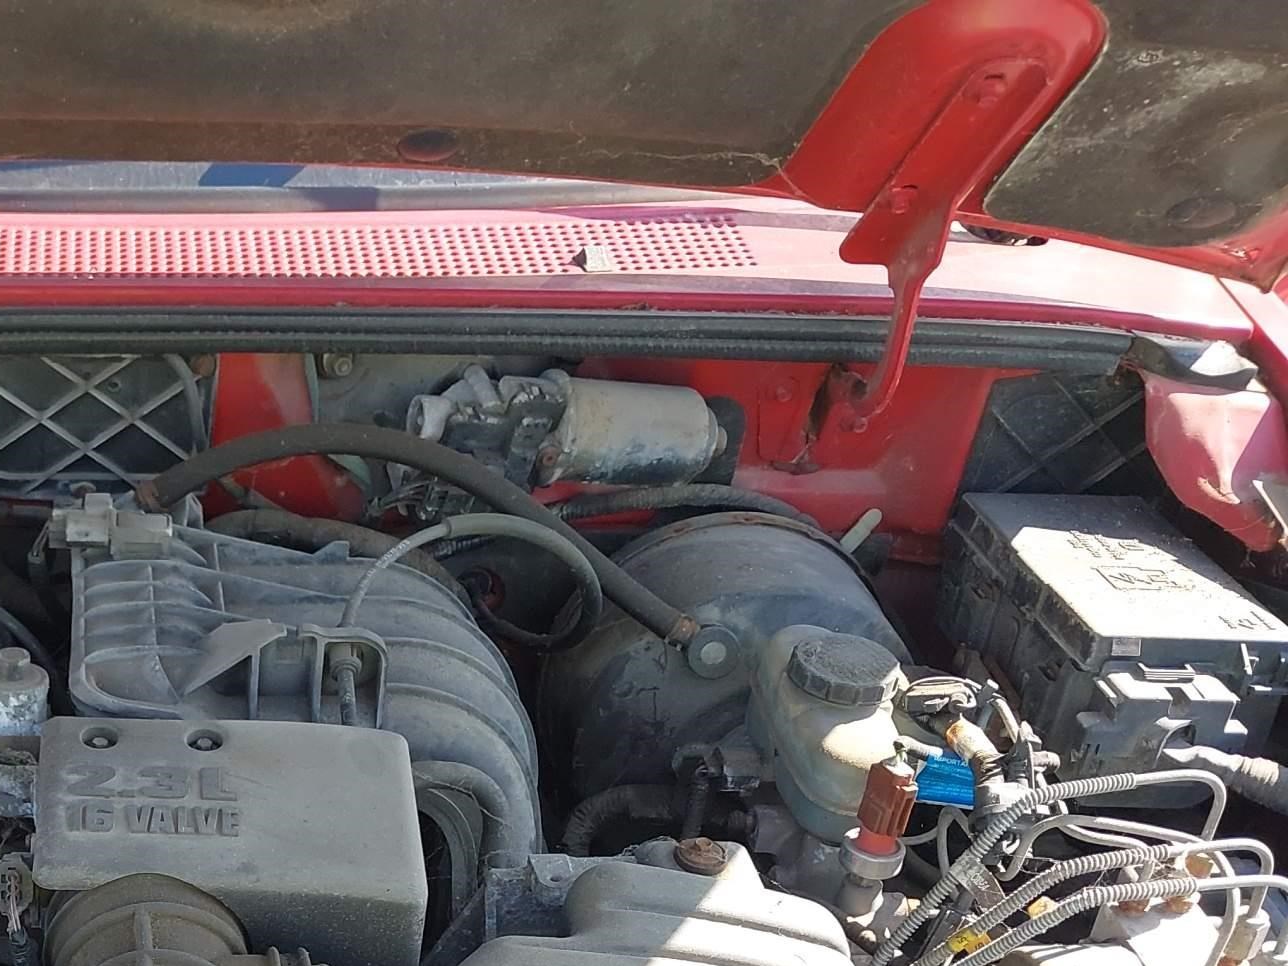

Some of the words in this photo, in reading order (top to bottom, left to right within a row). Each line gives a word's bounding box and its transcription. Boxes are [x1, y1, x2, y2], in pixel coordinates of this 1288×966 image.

[933, 755, 969, 768] IMPORTA
[64, 765, 238, 801] 2.3L
[65, 805, 114, 833] 16
[125, 806, 241, 837] VALVE
